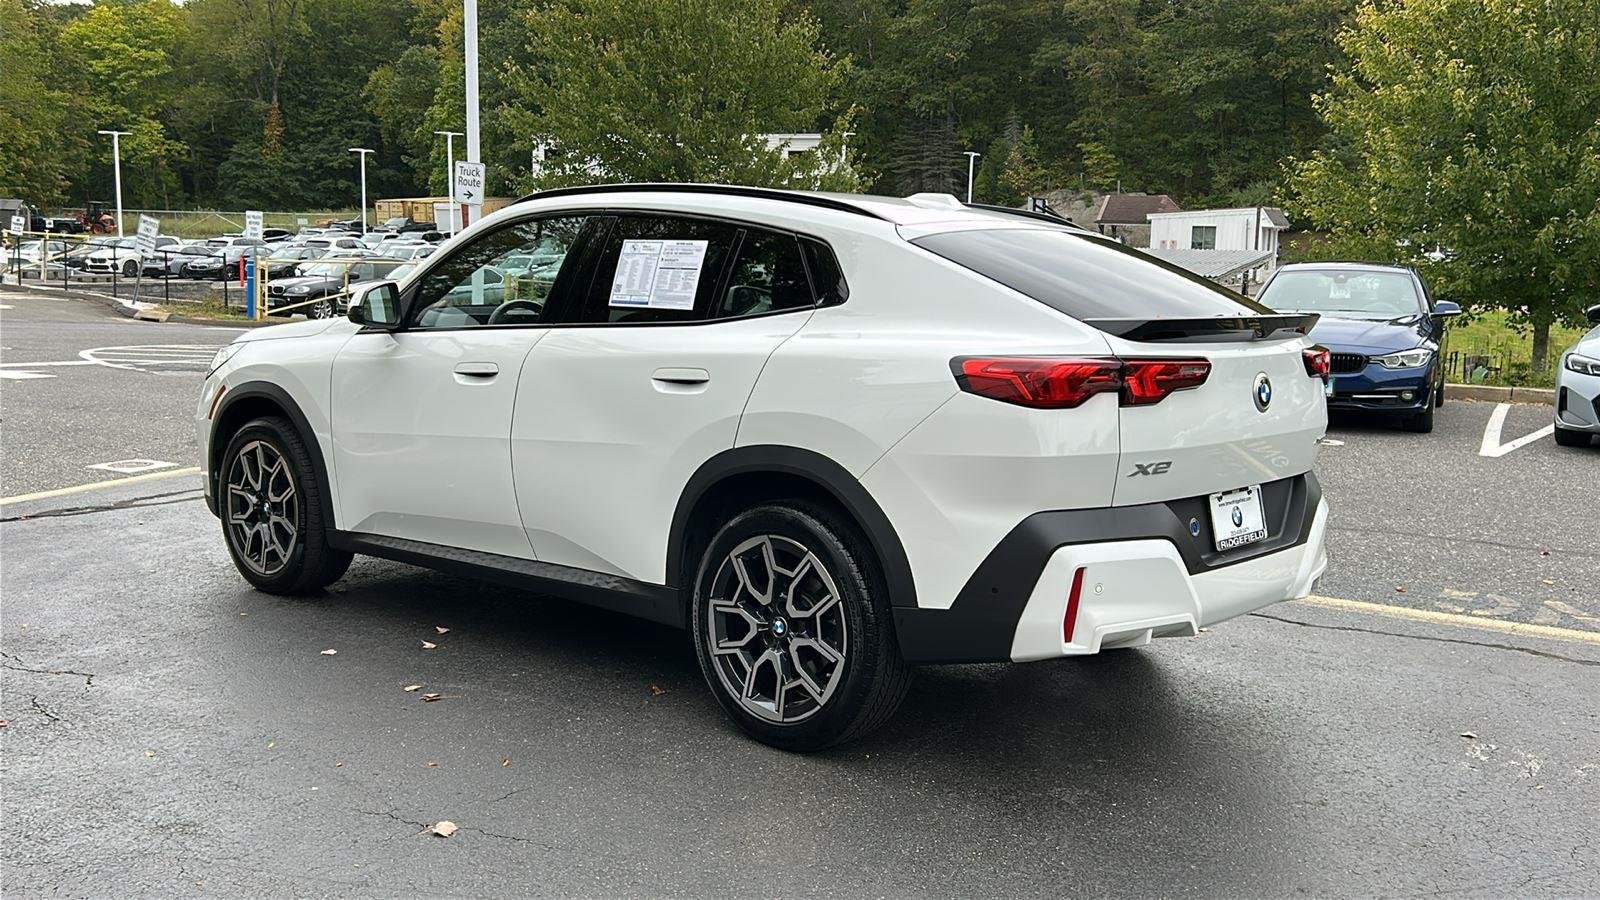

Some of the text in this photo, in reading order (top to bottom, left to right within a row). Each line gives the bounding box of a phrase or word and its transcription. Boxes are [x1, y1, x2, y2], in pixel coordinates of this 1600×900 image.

[459, 165, 481, 177] Truck
[458, 176, 481, 188] Route
[1126, 461, 1173, 478] X2
[1220, 530, 1265, 550] RIDGEFIELD
